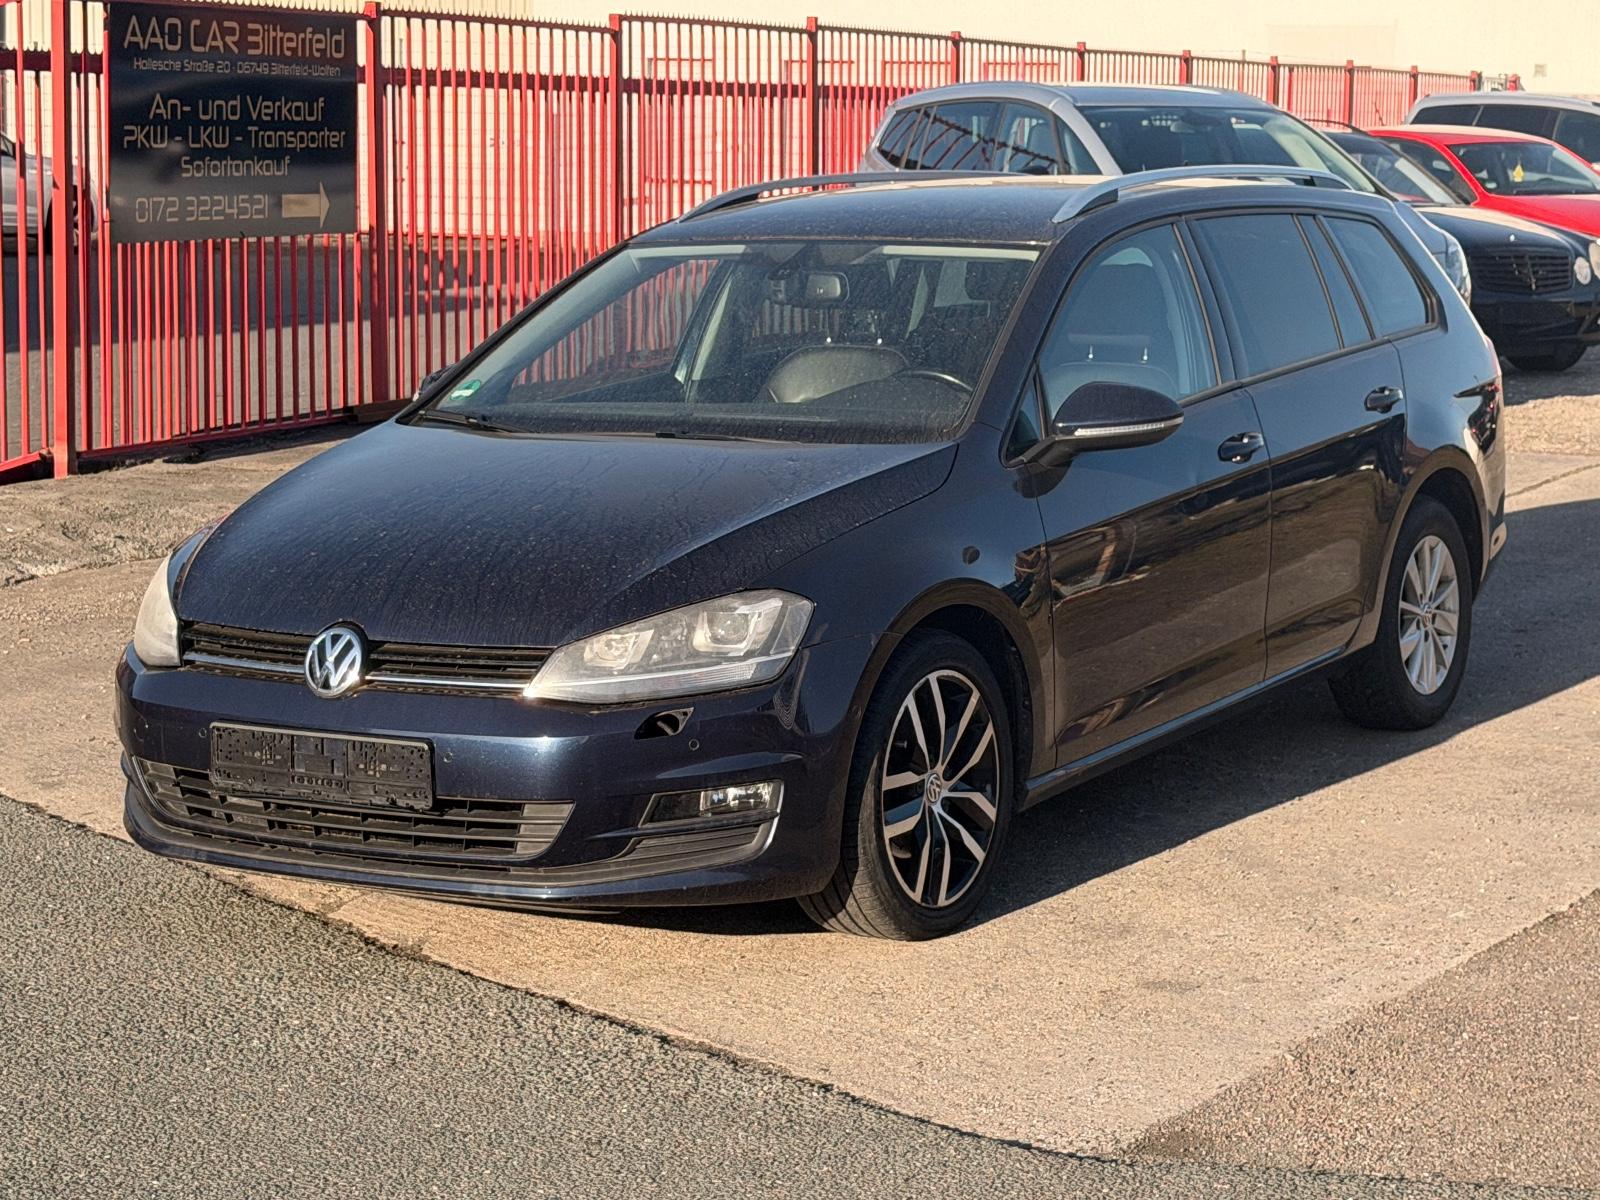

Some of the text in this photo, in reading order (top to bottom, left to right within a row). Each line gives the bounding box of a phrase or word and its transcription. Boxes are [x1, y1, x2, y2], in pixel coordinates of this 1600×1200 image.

[190, 19, 240, 55] CAR
[247, 23, 345, 59] Bitterfeld
[134, 57, 182, 72] Hallesche
[216, 60, 231, 74] 20
[237, 61, 269, 75] 06749
[149, 92, 325, 122] An- und Verkauf
[123, 125, 168, 149] PKW
[188, 125, 230, 149] LKW
[247, 126, 346, 152] Transporter
[181, 155, 290, 178] Sofortankauf
[135, 193, 269, 223] 0172 3224521
